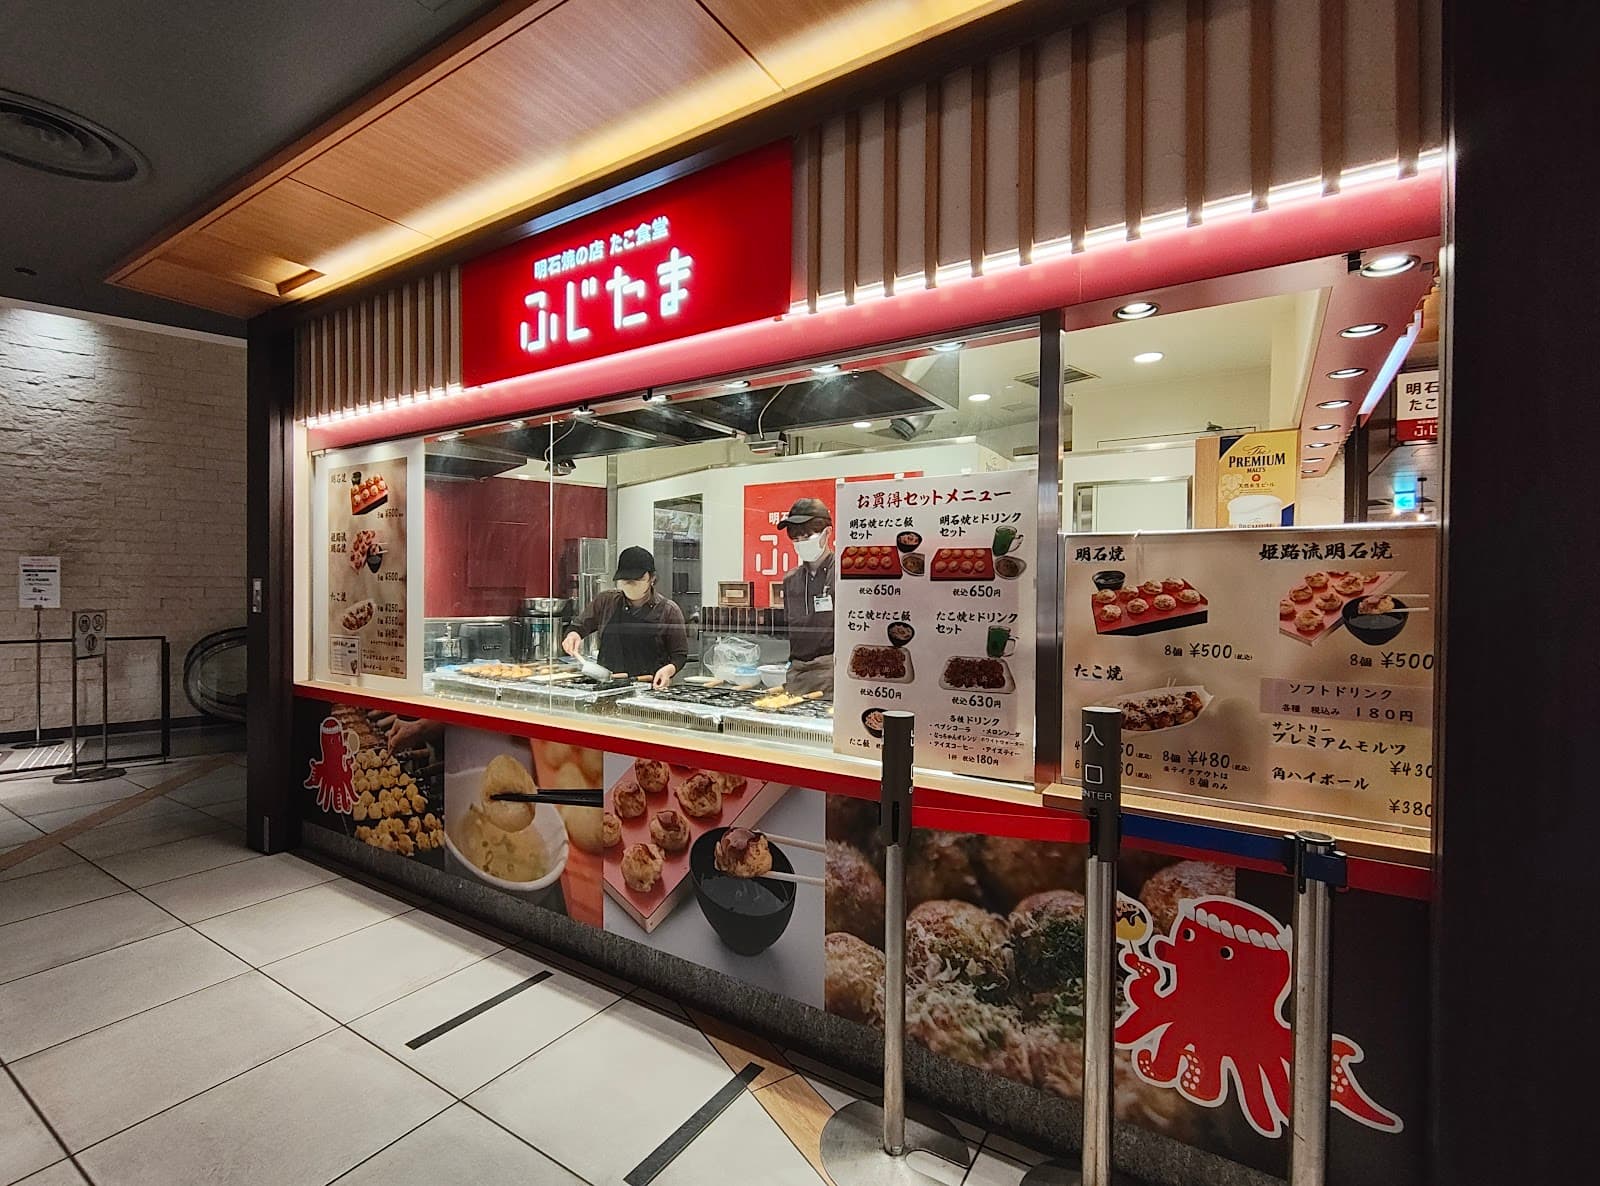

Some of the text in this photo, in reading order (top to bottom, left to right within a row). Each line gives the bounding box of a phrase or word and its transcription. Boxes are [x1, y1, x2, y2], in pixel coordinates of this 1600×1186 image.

[534, 215, 669, 279] 明石焼の店 たこ食堂
[519, 247, 693, 352] ふじたま
[1229, 452, 1285, 468] PREMIUM
[857, 488, 1011, 509] お買得セットメニュー
[849, 516, 914, 529] 明石焼とたこ飯
[939, 512, 1022, 526] 明石焼とドリンク
[849, 530, 873, 540] セット
[939, 526, 966, 538] セット
[1074, 545, 1126, 562] 明石焼
[1258, 541, 1394, 561] 姫路流明石焼
[859, 584, 901, 596] 税込650円
[952, 585, 1001, 597] 税込650円
[847, 609, 911, 622] たこ焼とたこ飯
[936, 611, 1018, 623] たこ焼とドリンク
[847, 621, 870, 632] セット
[936, 623, 962, 635] セット
[1189, 642, 1233, 659] ¥500
[1349, 651, 1434, 670] 8個 ¥500
[1074, 663, 1124, 681] たこ焼
[860, 686, 901, 699] 税込650円
[1289, 683, 1393, 701] ソフトドリンク
[952, 694, 1001, 708] 税込630円
[1310, 705, 1341, 716] 税込み
[1272, 721, 1332, 734] サントリー
[1272, 732, 1407, 756] プレミアムモルツ
[1187, 749, 1230, 769] ¥480
[1271, 766, 1370, 791] 角ハイボール
